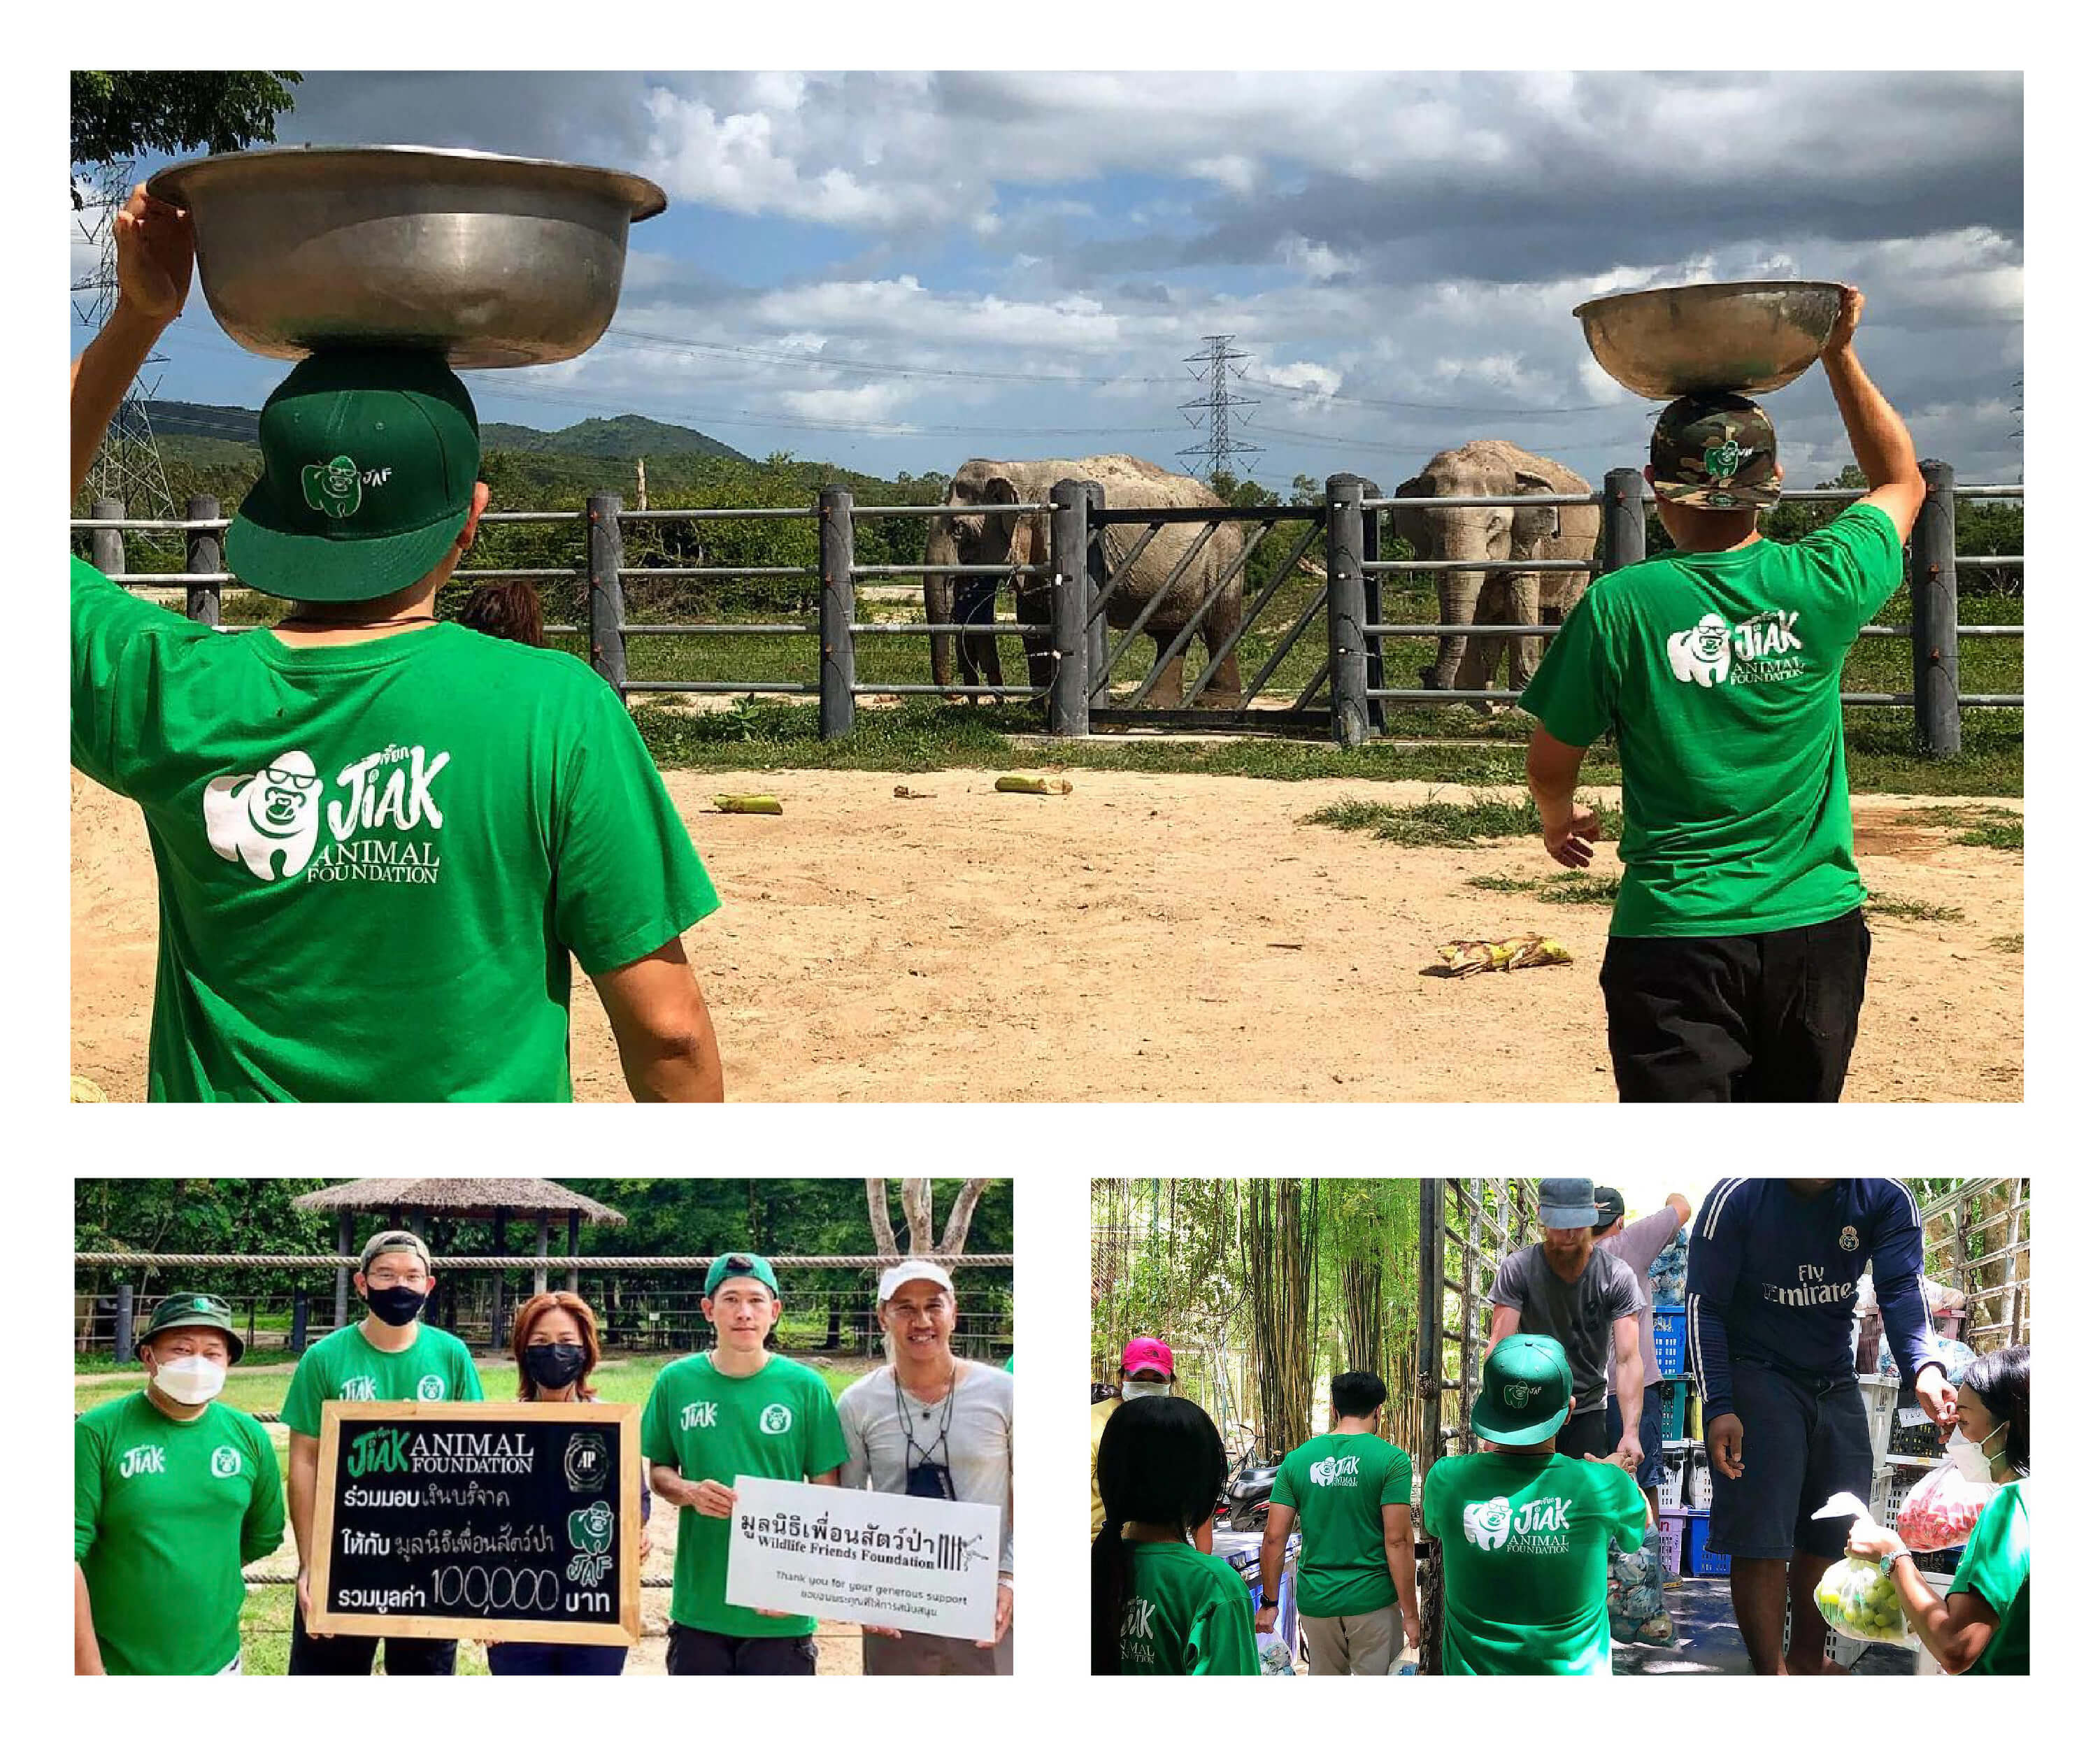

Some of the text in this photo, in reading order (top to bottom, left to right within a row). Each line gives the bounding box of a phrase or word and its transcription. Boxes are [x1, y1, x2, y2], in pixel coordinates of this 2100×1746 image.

[313, 840, 441, 868] ANIMAL
[307, 864, 438, 884] FOUNDATION
[1798, 1264, 1824, 1282] Fly
[1762, 1282, 1855, 1306] Emirate
[409, 1433, 534, 1457] ANIMAL
[412, 1457, 534, 1473] FOUNDATION
[577, 1451, 596, 1468] AP
[344, 1484, 420, 1507] ร่วมมอบ
[341, 1529, 390, 1555] ให้กับ
[741, 1511, 934, 1554] มูลนิธิเพื่อนสัตว์ป่า
[1508, 1535, 1569, 1546] ANIMAL
[758, 1536, 935, 1569] Wildlife Friends Foundation
[1506, 1544, 1569, 1554] FOUNDATION
[566, 1554, 613, 1587] JAF
[338, 1566, 610, 1615] รวมมูลค่า 100,000 บาท
[776, 1570, 968, 1606] Thank you for your generous support
